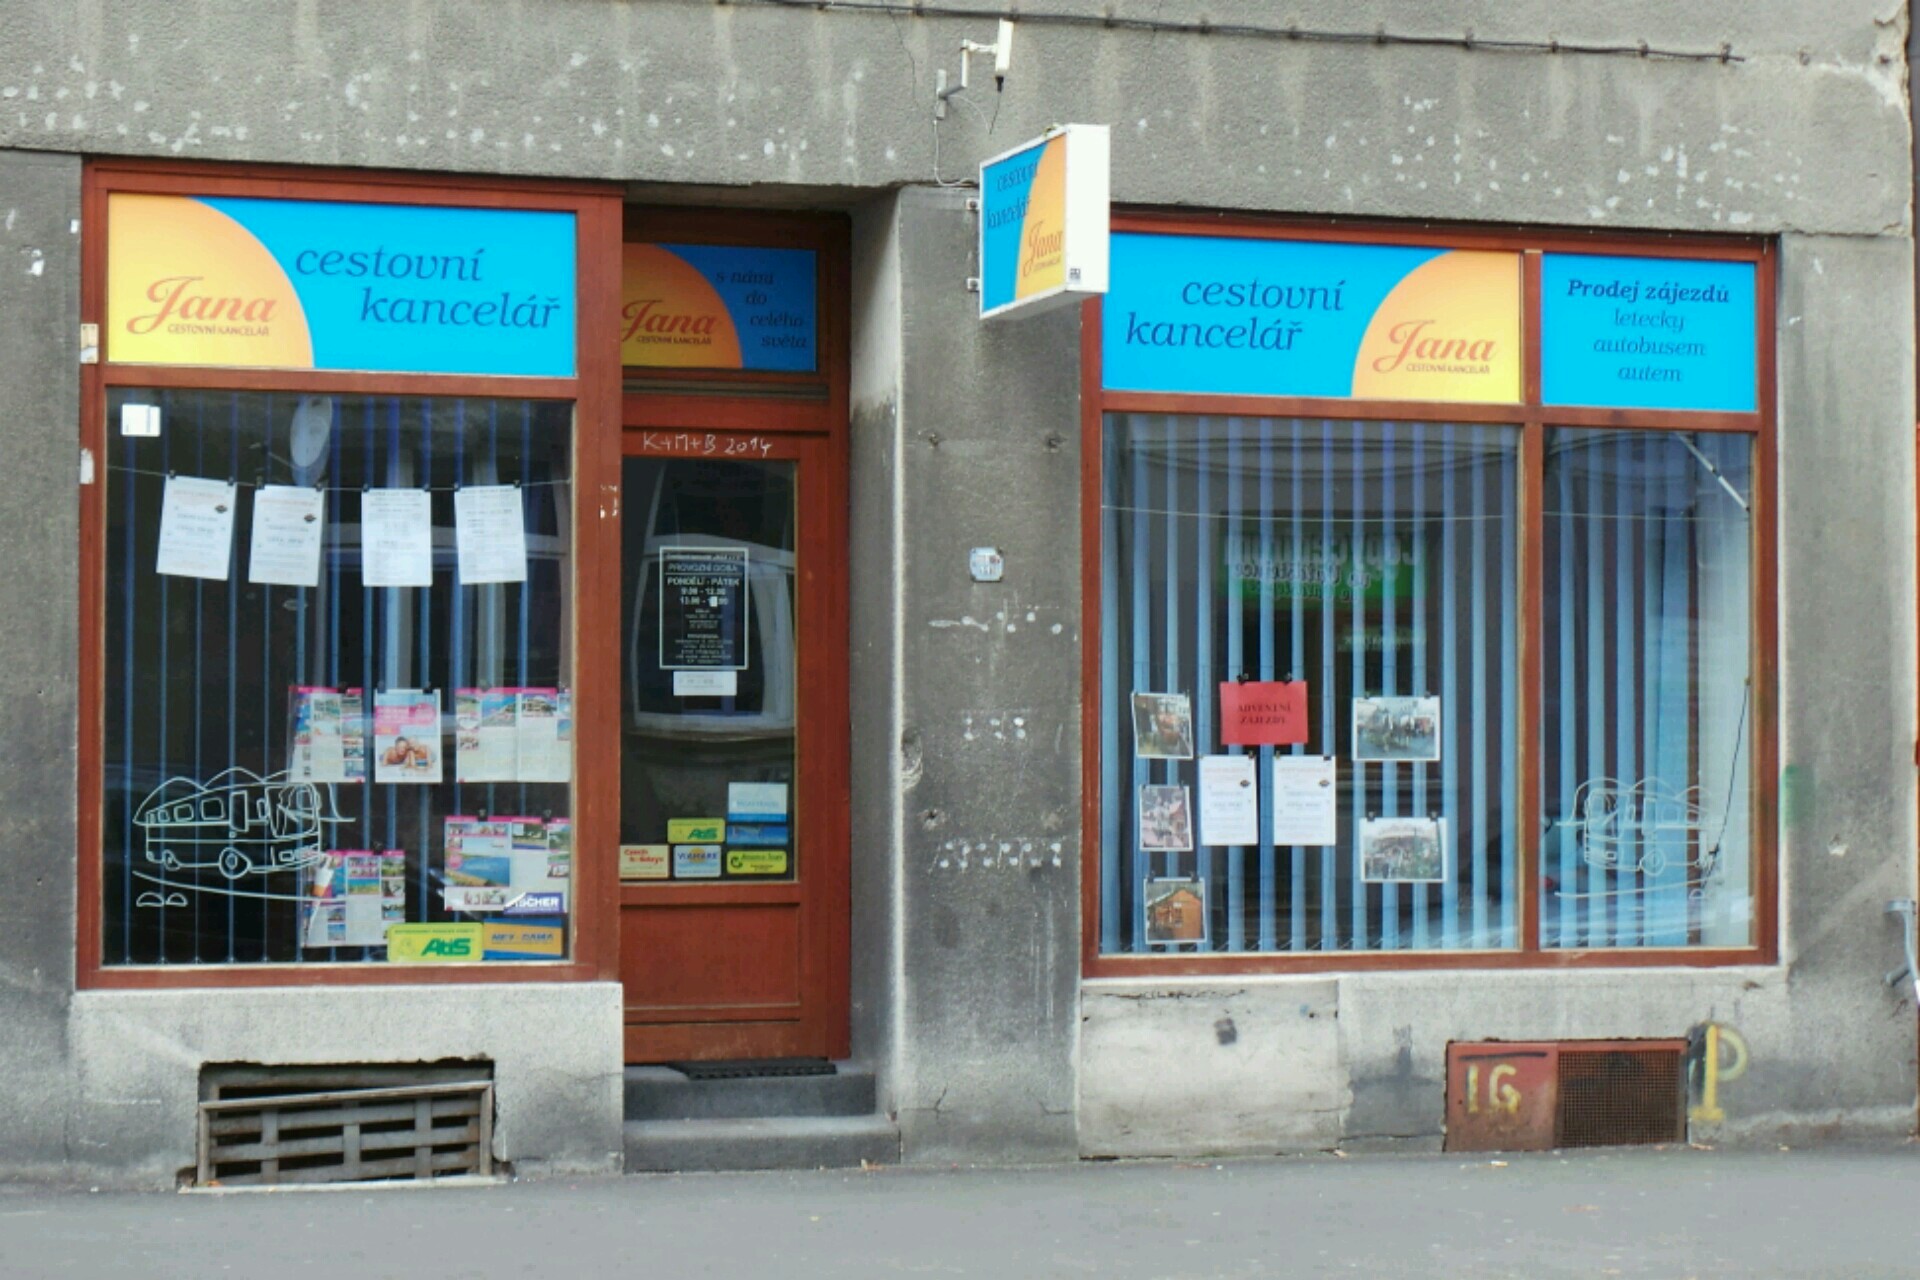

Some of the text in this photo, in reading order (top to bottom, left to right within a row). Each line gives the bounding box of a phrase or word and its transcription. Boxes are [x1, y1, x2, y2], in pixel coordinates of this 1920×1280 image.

[295, 245, 486, 281] cestovní
[126, 275, 277, 335] Jana
[360, 286, 561, 329] kancelář
[746, 290, 767, 305] do
[1182, 279, 1345, 311] cestovní
[1567, 279, 1730, 305] Prodej zájezdů
[621, 299, 717, 343] Jana
[1126, 313, 1303, 351] kancelář
[1614, 307, 1685, 333] letecky
[1372, 319, 1497, 374] Jana
[1592, 336, 1706, 356] autobusem
[1617, 365, 1682, 382] autem
